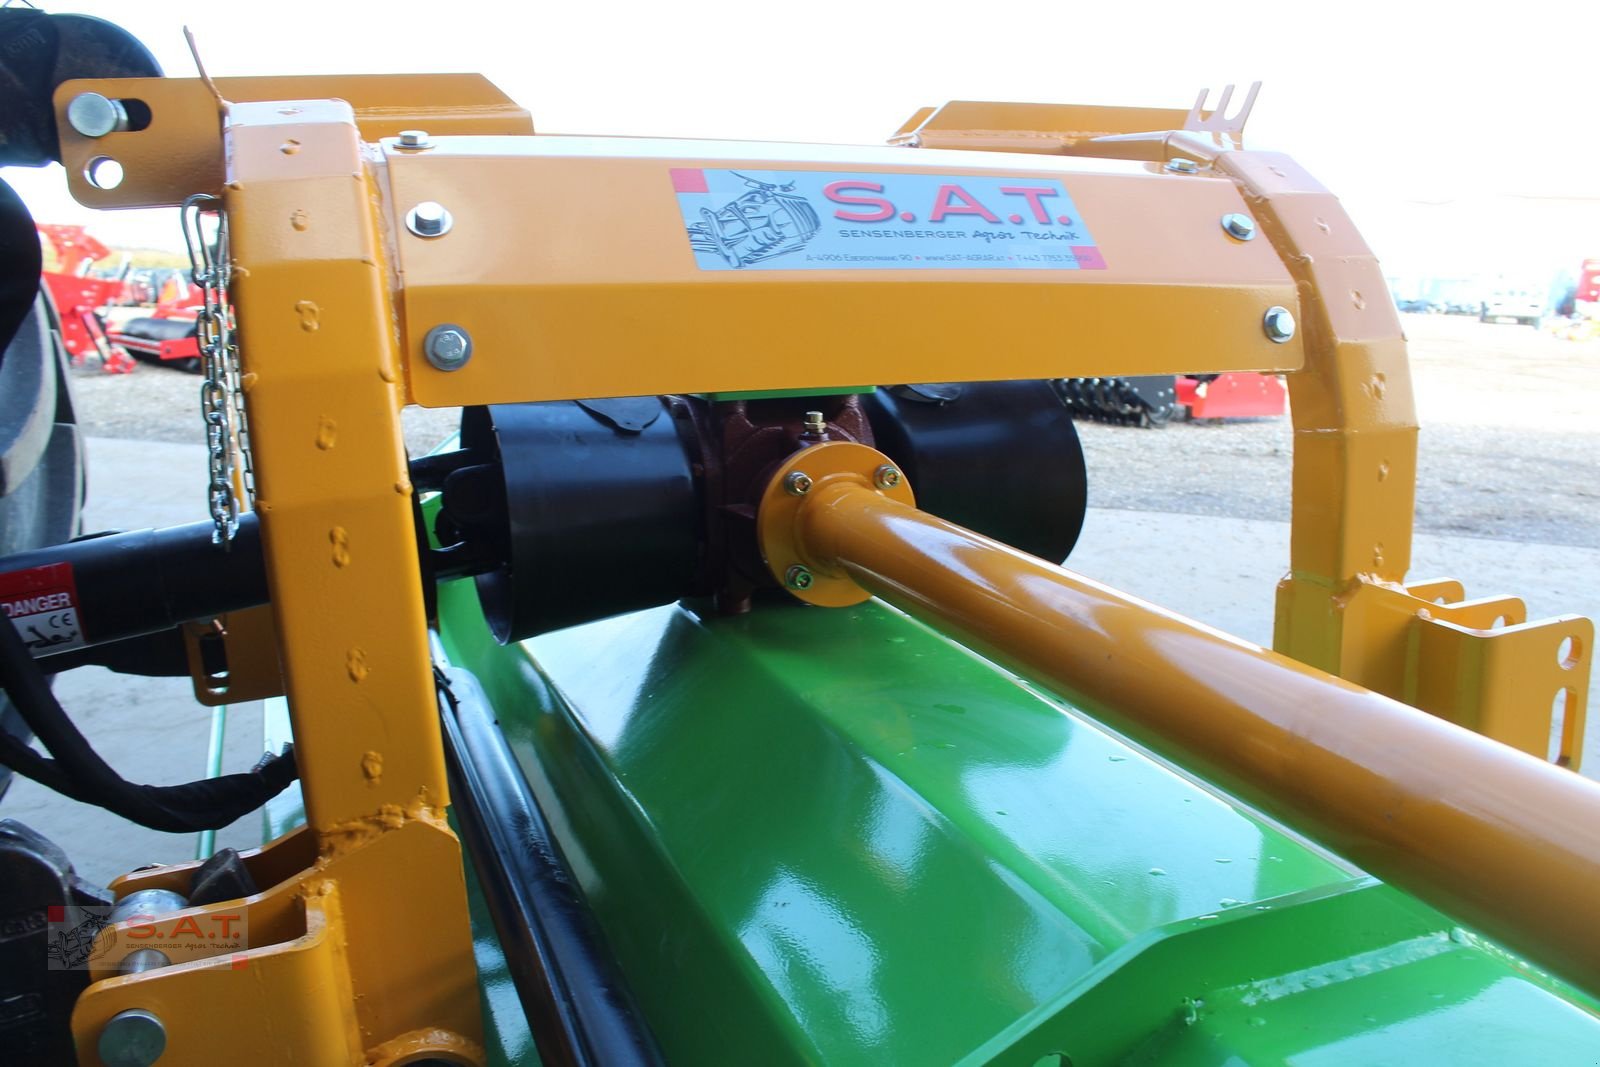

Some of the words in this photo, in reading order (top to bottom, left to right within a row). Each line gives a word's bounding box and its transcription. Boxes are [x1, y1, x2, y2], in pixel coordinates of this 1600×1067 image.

[822, 180, 1074, 226] S.A.T.
[839, 229, 967, 239] SENSENBERGER
[1020, 230, 1081, 242] Technik
[0, 592, 72, 617] DANGER
[48, 612, 73, 628] CE
